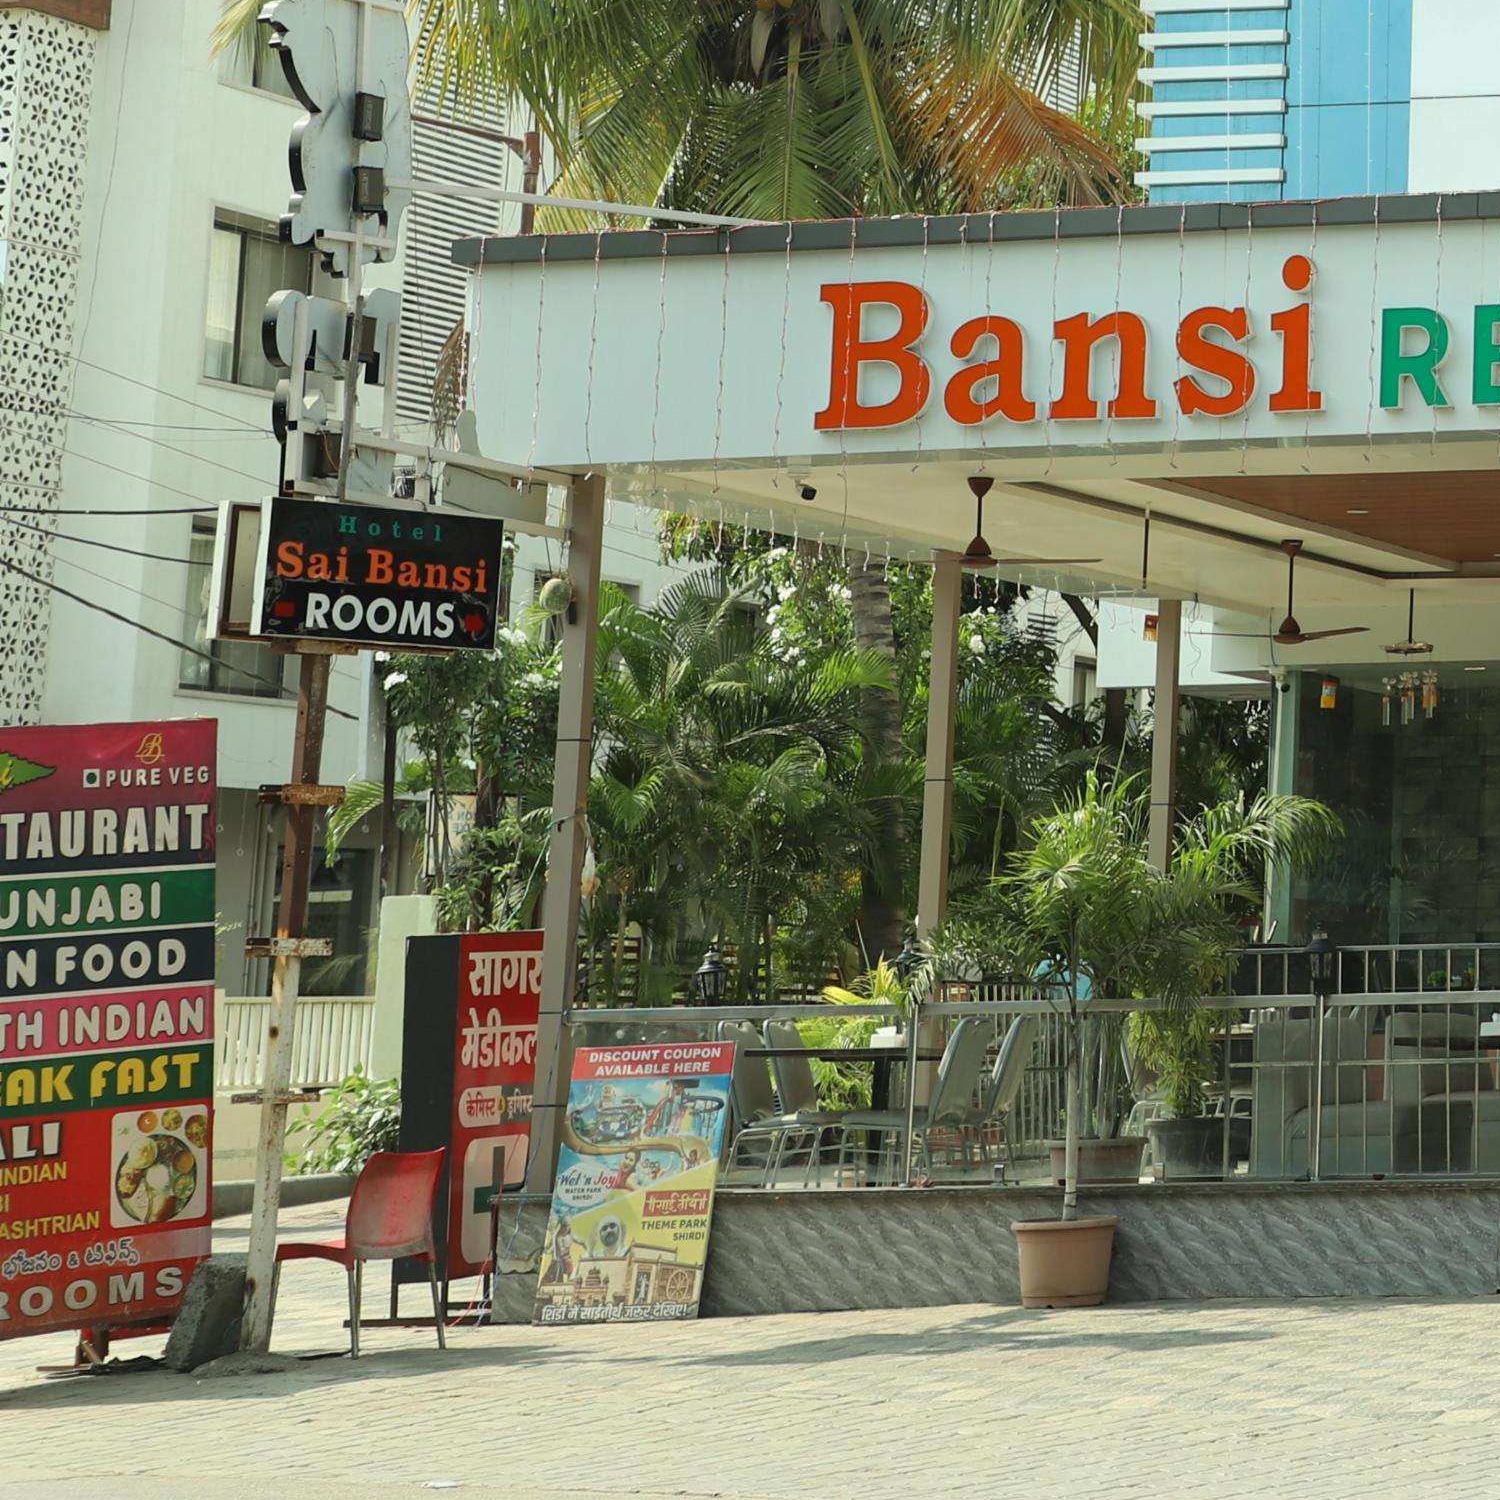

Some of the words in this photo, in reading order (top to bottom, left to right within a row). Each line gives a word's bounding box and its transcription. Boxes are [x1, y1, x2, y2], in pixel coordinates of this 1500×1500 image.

[814, 255, 1323, 431] Bansi
[339, 514, 443, 542] Hotel
[276, 540, 349, 582] Sai
[365, 549, 488, 593] Bansi
[305, 592, 455, 639] ROOMS
[106, 768, 161, 787] PURE
[168, 765, 209, 785] VEG
[56, 938, 186, 985] FOOD
[58, 997, 204, 1046] INDIAN
[589, 1049, 660, 1063] DISCOUNT
[663, 1047, 721, 1060] COUPON
[595, 1063, 669, 1076] AVAILABLE
[673, 1061, 710, 1073] HERE
[0, 1064, 74, 1107] AK
[90, 1052, 200, 1098] FAST
[0, 1161, 67, 1187] INDIAN
[593, 1171, 616, 1189] Joy
[641, 1220, 677, 1230] THEME
[679, 1219, 707, 1229] PARK
[673, 1232, 705, 1241] SHIRDI
[0, 1267, 183, 1321] ROOMS
